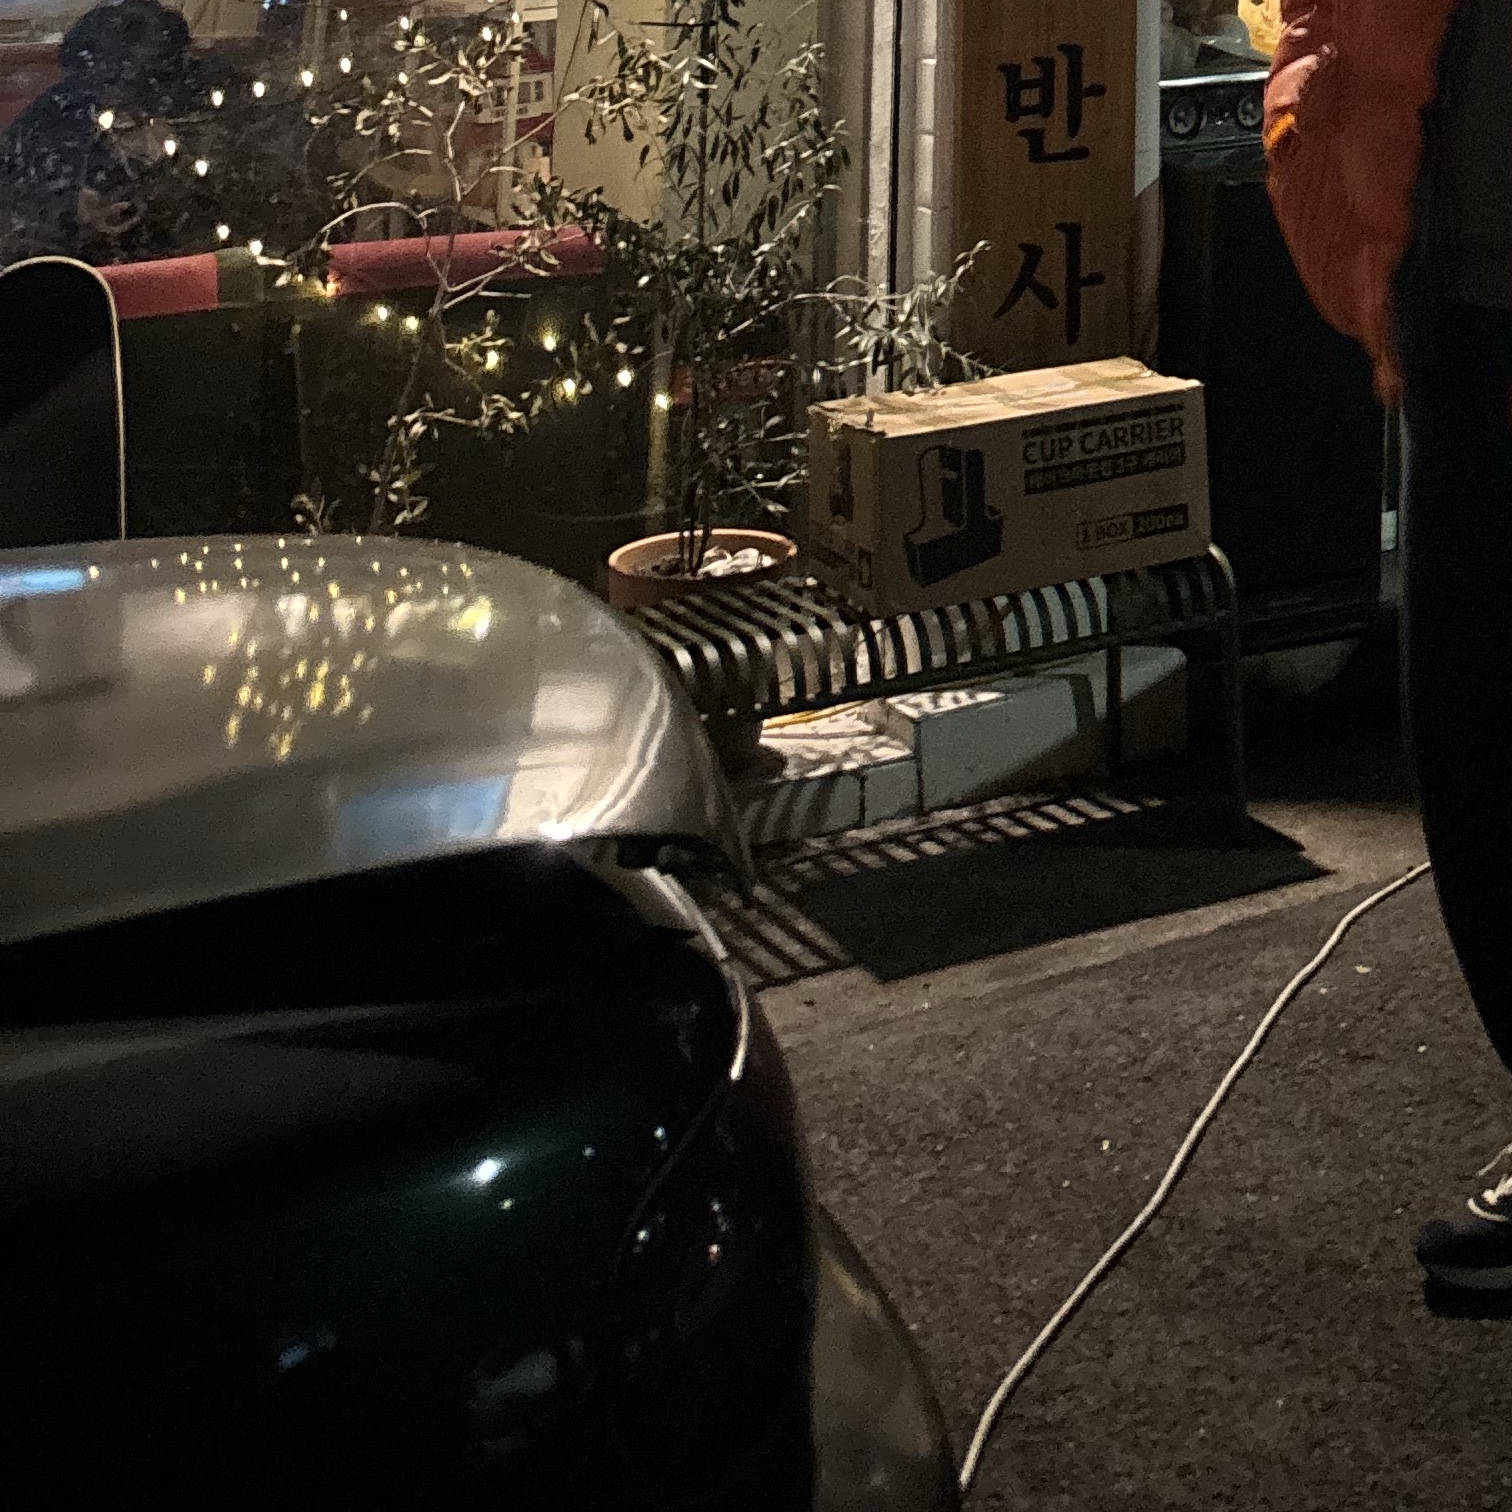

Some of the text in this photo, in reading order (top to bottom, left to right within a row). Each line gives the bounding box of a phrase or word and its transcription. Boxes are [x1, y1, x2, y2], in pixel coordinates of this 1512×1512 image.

[1022, 436, 1073, 465] CUP
[1080, 417, 1185, 455] CARRIER
[1096, 520, 1129, 542] BOX
